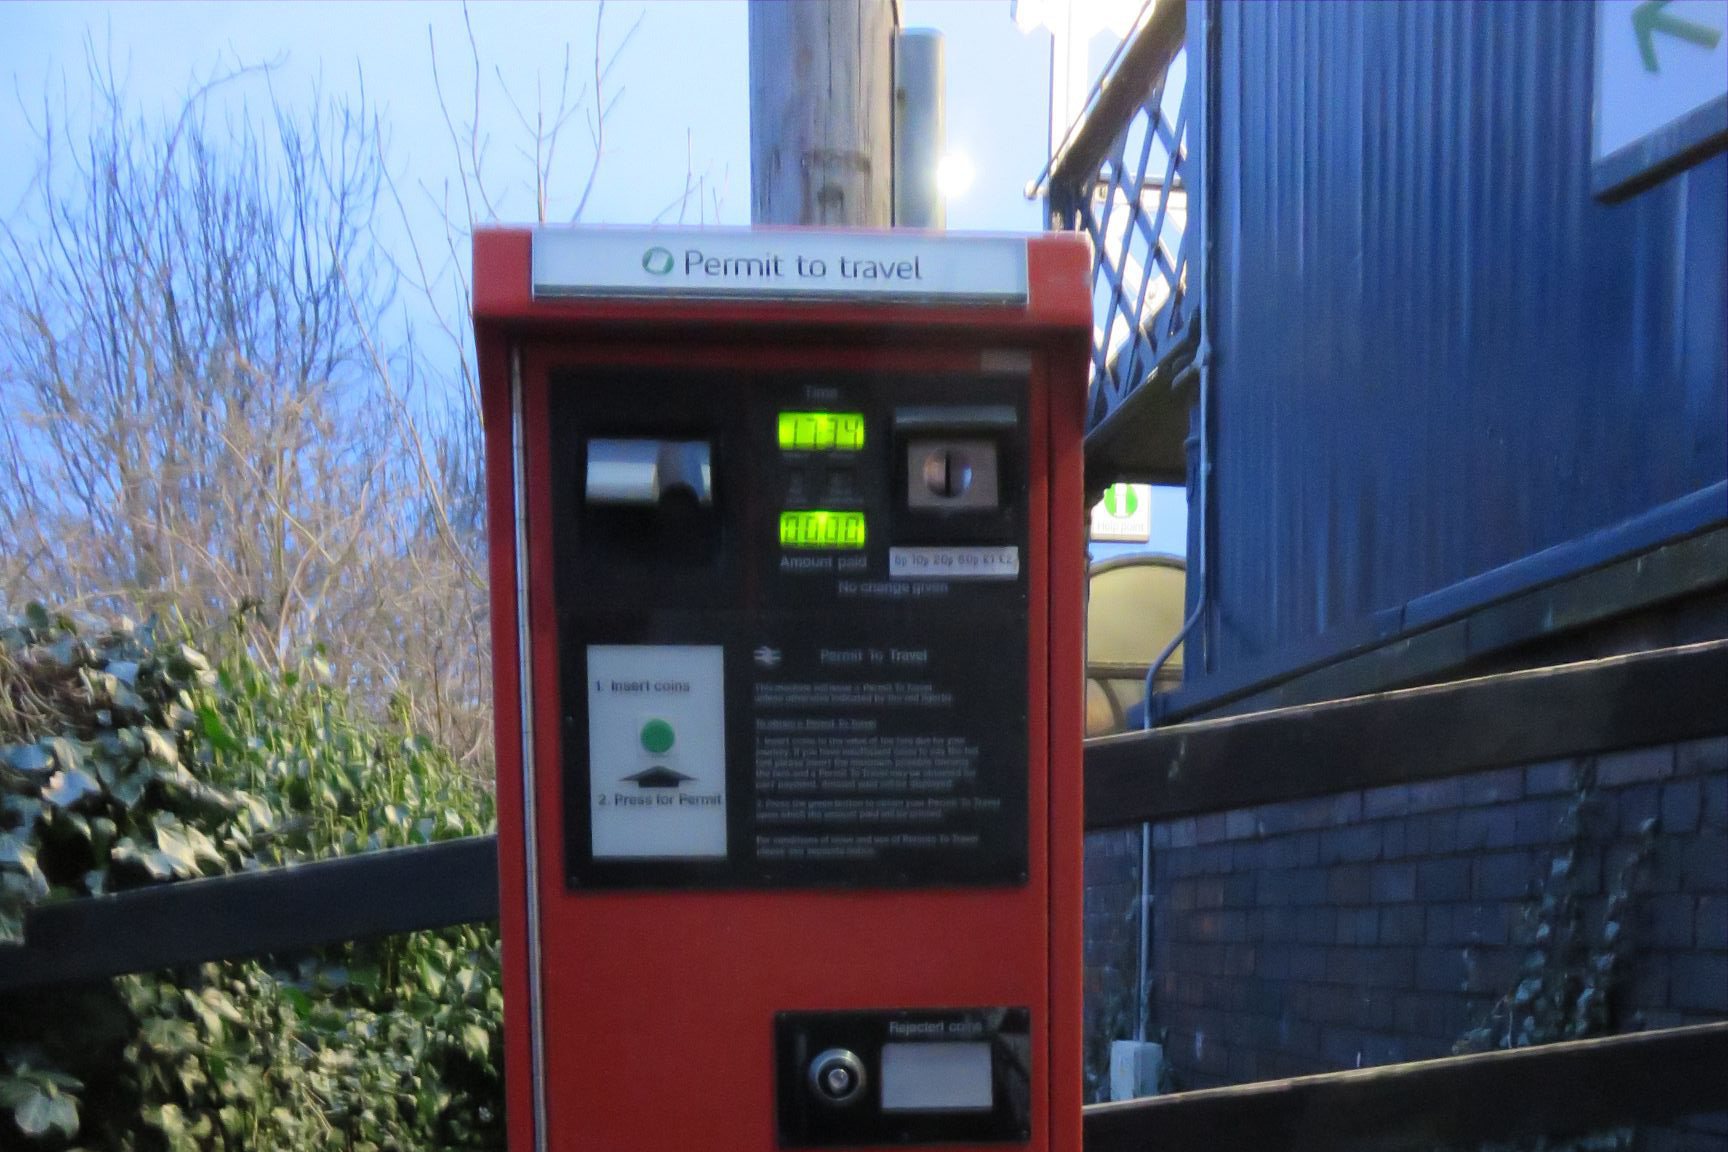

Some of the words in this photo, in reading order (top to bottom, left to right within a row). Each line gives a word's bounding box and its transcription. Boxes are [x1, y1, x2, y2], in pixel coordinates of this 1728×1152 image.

[685, 249, 786, 277] Permit
[797, 255, 827, 278] to
[840, 255, 924, 281] travel
[780, 556, 833, 569] Amount
[837, 555, 868, 572] paid
[838, 580, 858, 593] No
[860, 580, 911, 596] change
[911, 580, 949, 597] given
[821, 648, 863, 663] Permit
[868, 648, 884, 663] To
[889, 647, 928, 663] Travel
[611, 679, 651, 692] Insert
[654, 680, 691, 693] coins
[614, 792, 653, 806] Press
[656, 793, 674, 806] for
[679, 792, 722, 806] Permit
[889, 1020, 945, 1036] Rejected
[949, 1020, 983, 1033] coins
